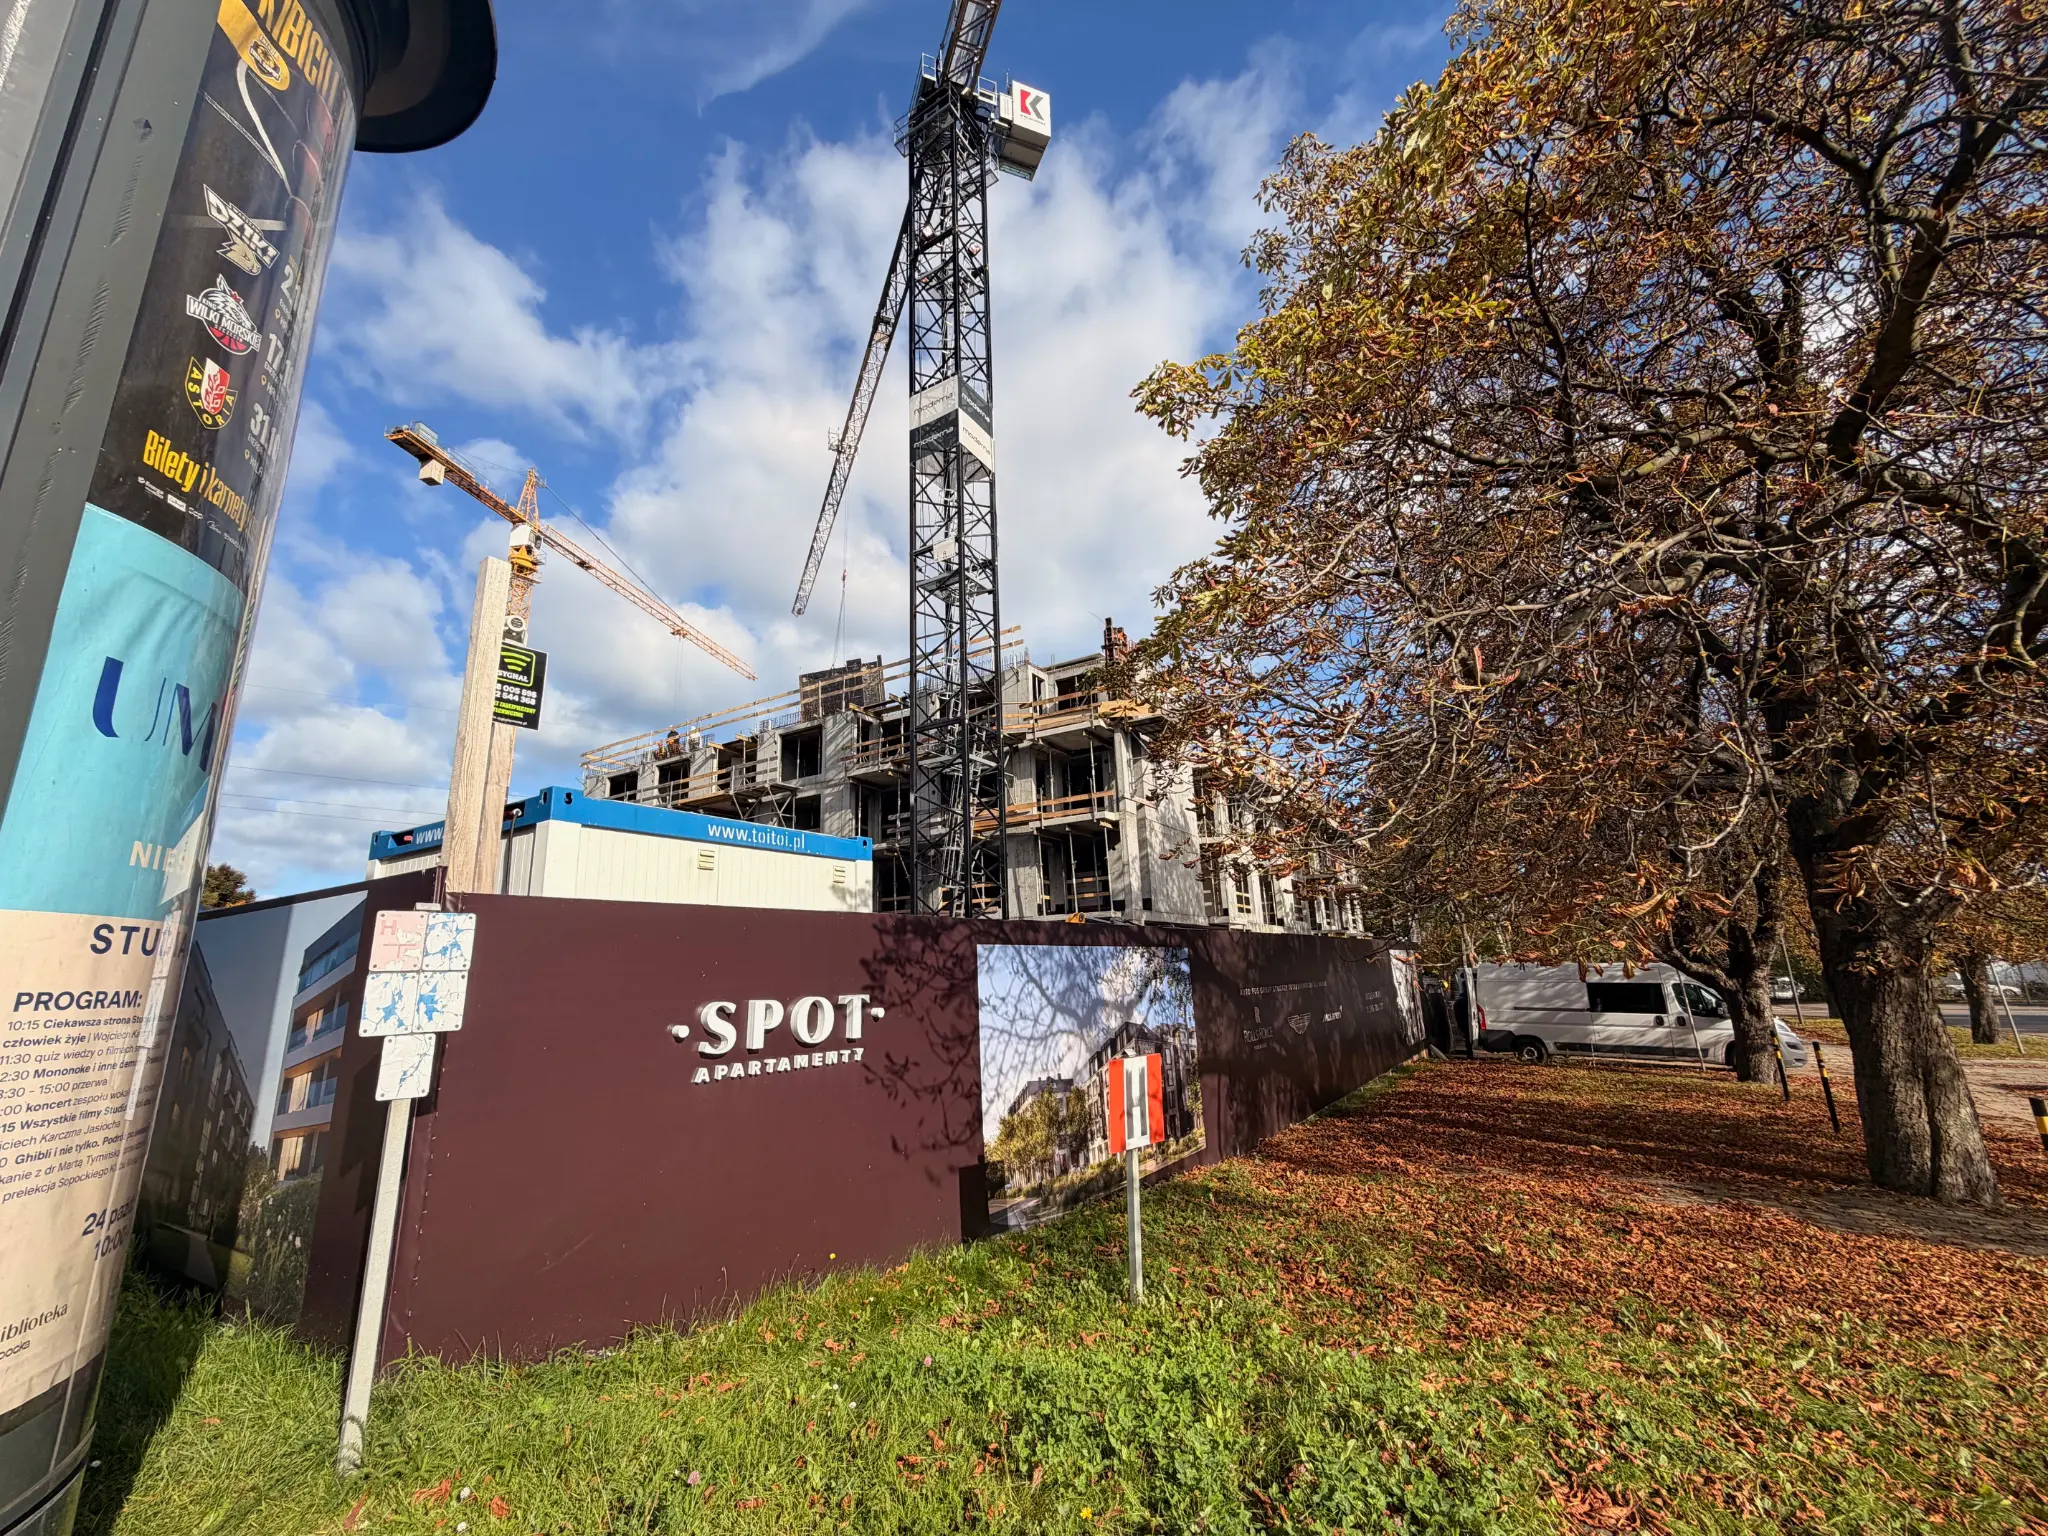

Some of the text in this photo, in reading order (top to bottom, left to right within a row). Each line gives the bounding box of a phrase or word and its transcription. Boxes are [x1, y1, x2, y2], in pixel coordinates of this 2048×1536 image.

[207, 188, 278, 265] DZIKI
[190, 298, 220, 325] WILKI
[221, 317, 261, 349] MORSKIE
[143, 429, 247, 531] Bilety i karnety
[708, 823, 805, 851] www.toitoi.pl
[13, 990, 143, 1012] PROGRAM:
[7, 1020, 40, 1031] 10:15
[43, 1017, 101, 1029] Ciekawsza
[103, 1015, 131, 1026] strona
[2, 1035, 61, 1048] człowiek
[65, 1033, 86, 1046] żyje
[93, 1030, 131, 1043] Wojciech
[35, 1051, 60, 1065] quiz
[63, 1048, 96, 1061] wiedzy
[105, 1044, 134, 1056] filmach
[691, 1047, 864, 1084] APARTAMENTY
[0, 1070, 29, 1083] 2:30
[33, 1066, 91, 1079] Mononoke
[97, 1060, 117, 1071] inne
[0, 1086, 26, 1100] 3:30
[39, 1083, 70, 1095] 15:00
[71, 1078, 107, 1093] przerwa
[25, 1098, 72, 1113] koncert
[73, 1092, 108, 1107] zespołu
[1126, 1067, 1147, 1140] H
[20, 1114, 77, 1133] Wszystkie
[79, 1108, 103, 1122] filmy
[39, 1127, 81, 1144] Karczma
[83, 1120, 121, 1136] Jasiocha
[15, 1146, 52, 1166] Ghibli
[59, 1143, 73, 1157] nie
[75, 1139, 100, 1157] tylko.
[0, 1171, 32, 1186] kanie
[34, 1168, 41, 1178] z
[44, 1165, 56, 1176] dr
[2, 1166, 109, 1204] prelekcja Sopockiego
[81, 1208, 107, 1237] 24
[0, 1303, 68, 1343] iblioteka
